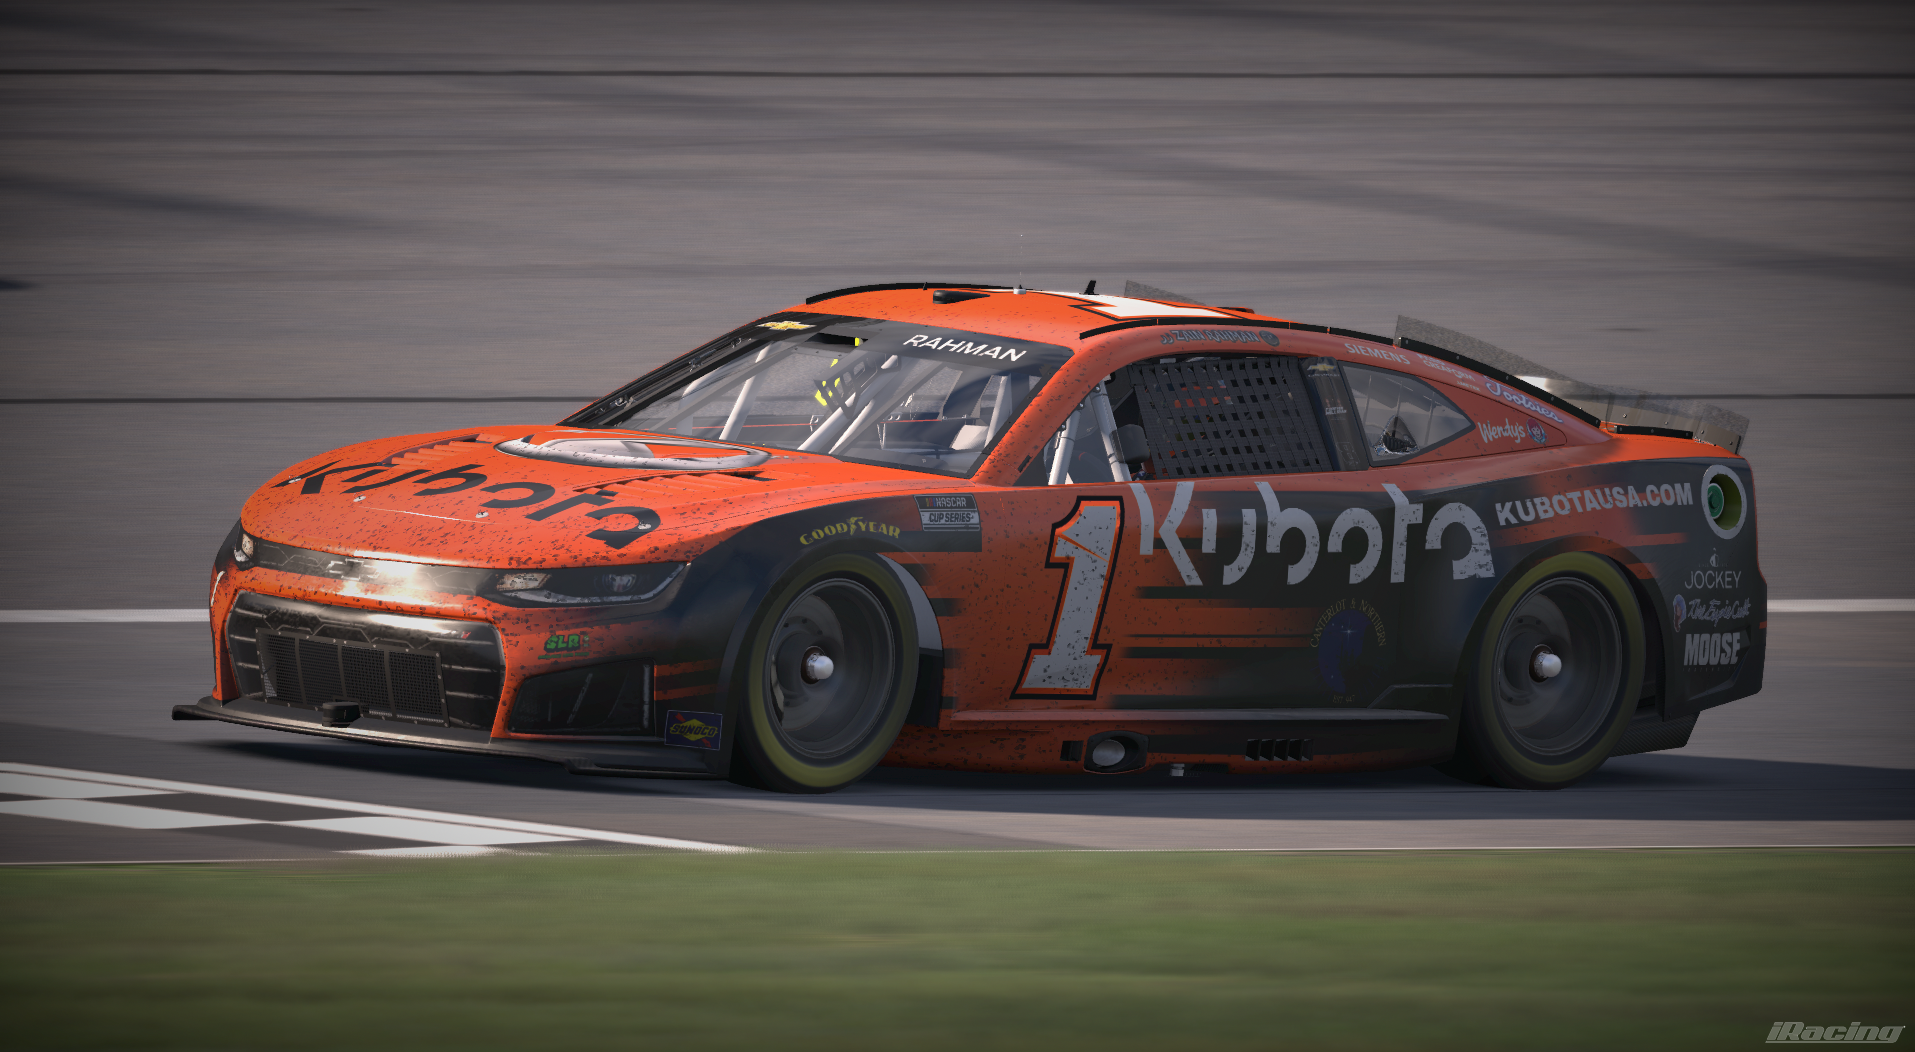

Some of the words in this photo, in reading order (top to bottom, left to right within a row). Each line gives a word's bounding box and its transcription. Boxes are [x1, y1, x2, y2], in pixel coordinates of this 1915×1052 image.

[903, 334, 1028, 362] RAHMAN
[1171, 330, 1205, 342] ZAIN
[1203, 330, 1261, 343] RAHMAN
[1344, 343, 1411, 365] SIEMENS
[1477, 418, 1526, 444] Wendy's
[271, 458, 662, 550] Kubota
[935, 497, 967, 508] NASCAR
[1494, 482, 1694, 527] KUBOTAUSA.COM
[929, 512, 945, 523] CUP
[944, 512, 972, 523] SERIES
[1127, 481, 1496, 587] Kubota
[1684, 570, 1743, 589] JOCKEY
[1013, 499, 1121, 697] 1
[1309, 598, 1347, 648] CANTERLOT
[1349, 597, 1357, 609] &
[1359, 598, 1387, 647] NORTHERN
[545, 634, 581, 653] SLR
[1683, 632, 1741, 666] MOOSE
[671, 723, 716, 737] SUNOCO
